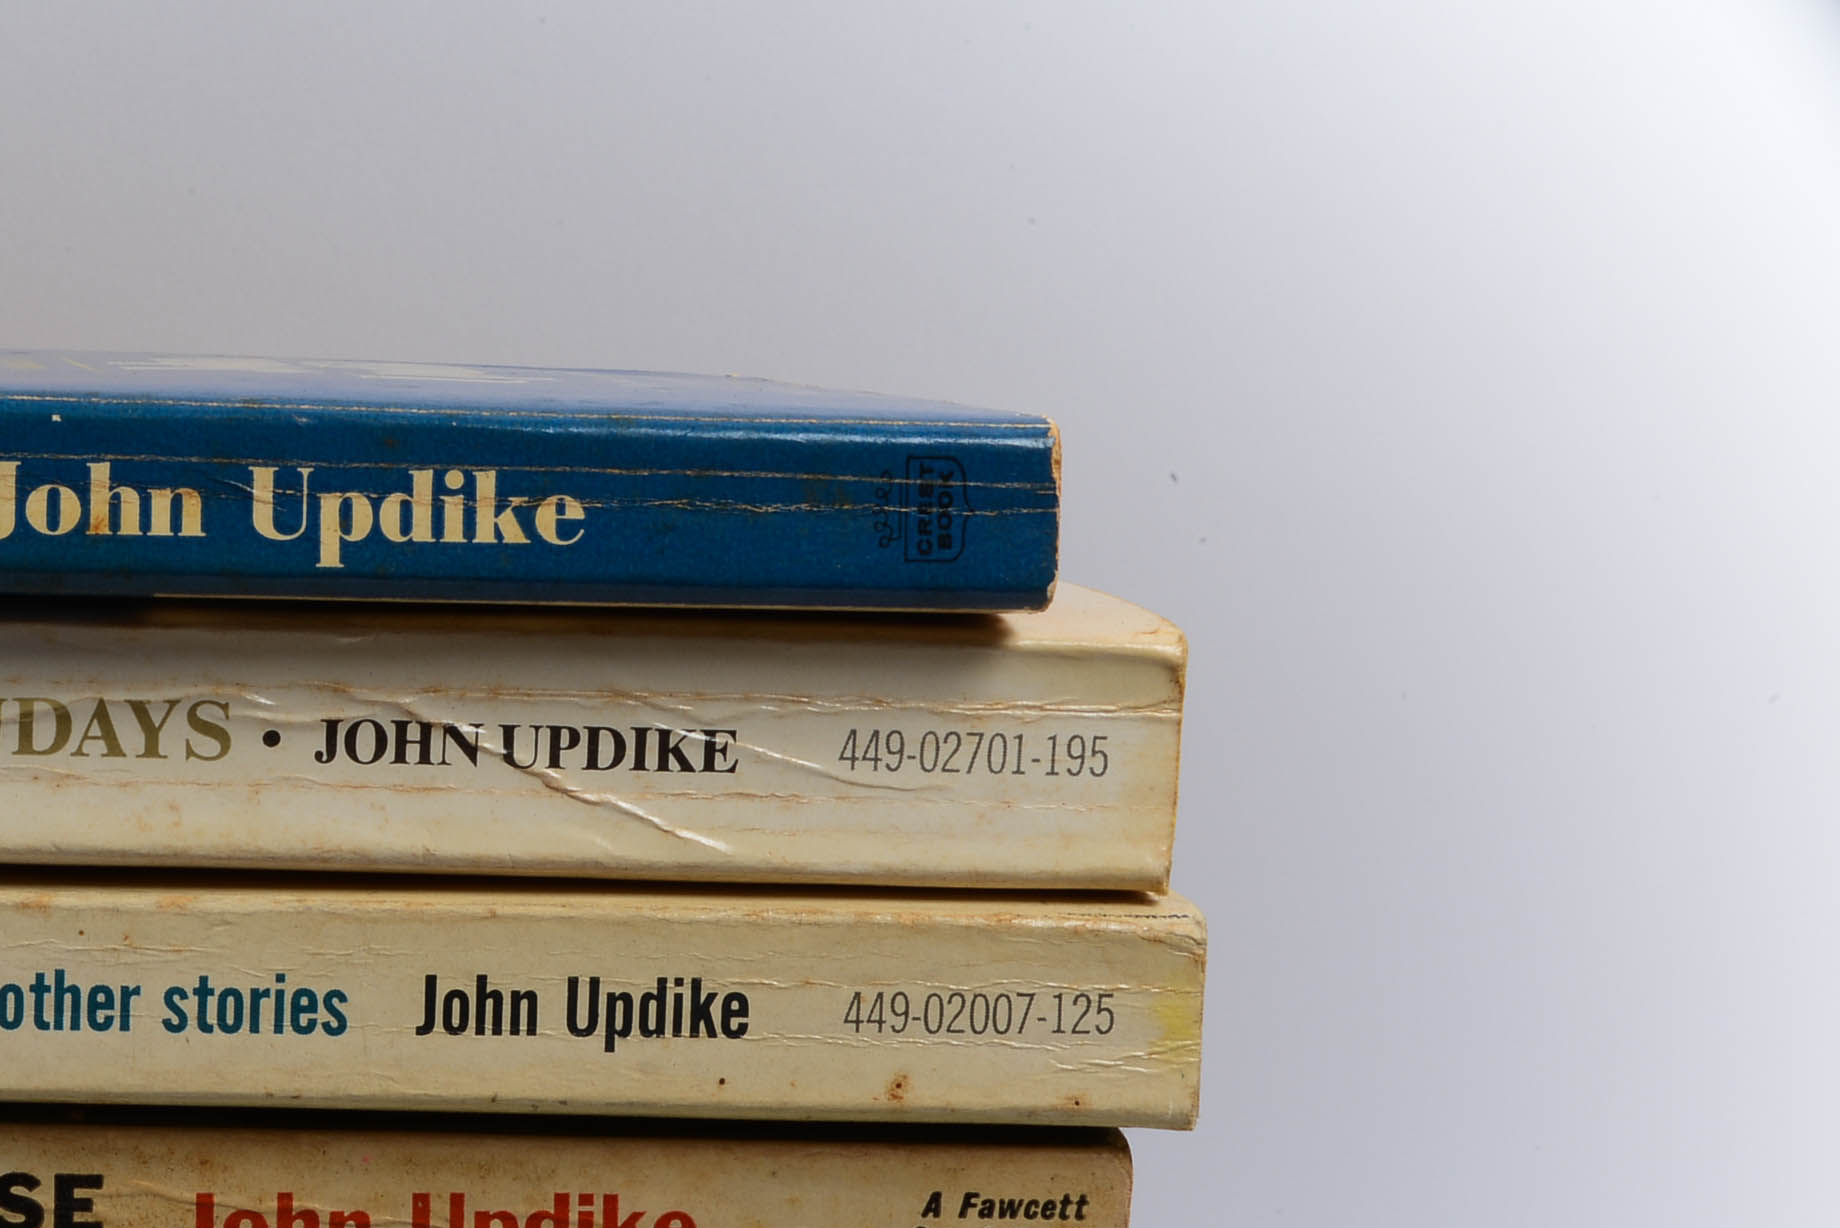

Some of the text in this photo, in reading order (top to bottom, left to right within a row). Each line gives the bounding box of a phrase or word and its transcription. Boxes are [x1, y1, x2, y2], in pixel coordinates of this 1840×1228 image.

[247, 466, 588, 568] Updike
[937, 471, 954, 550] BOOK
[315, 717, 740, 776] JOHN UPDIKE
[838, 729, 1107, 777] 449-02701-195
[162, 973, 347, 1036] stories
[416, 975, 749, 1052] John Updike
[844, 992, 1114, 1035] 449-02007-125
[921, 1191, 1089, 1221] A Fawcett
